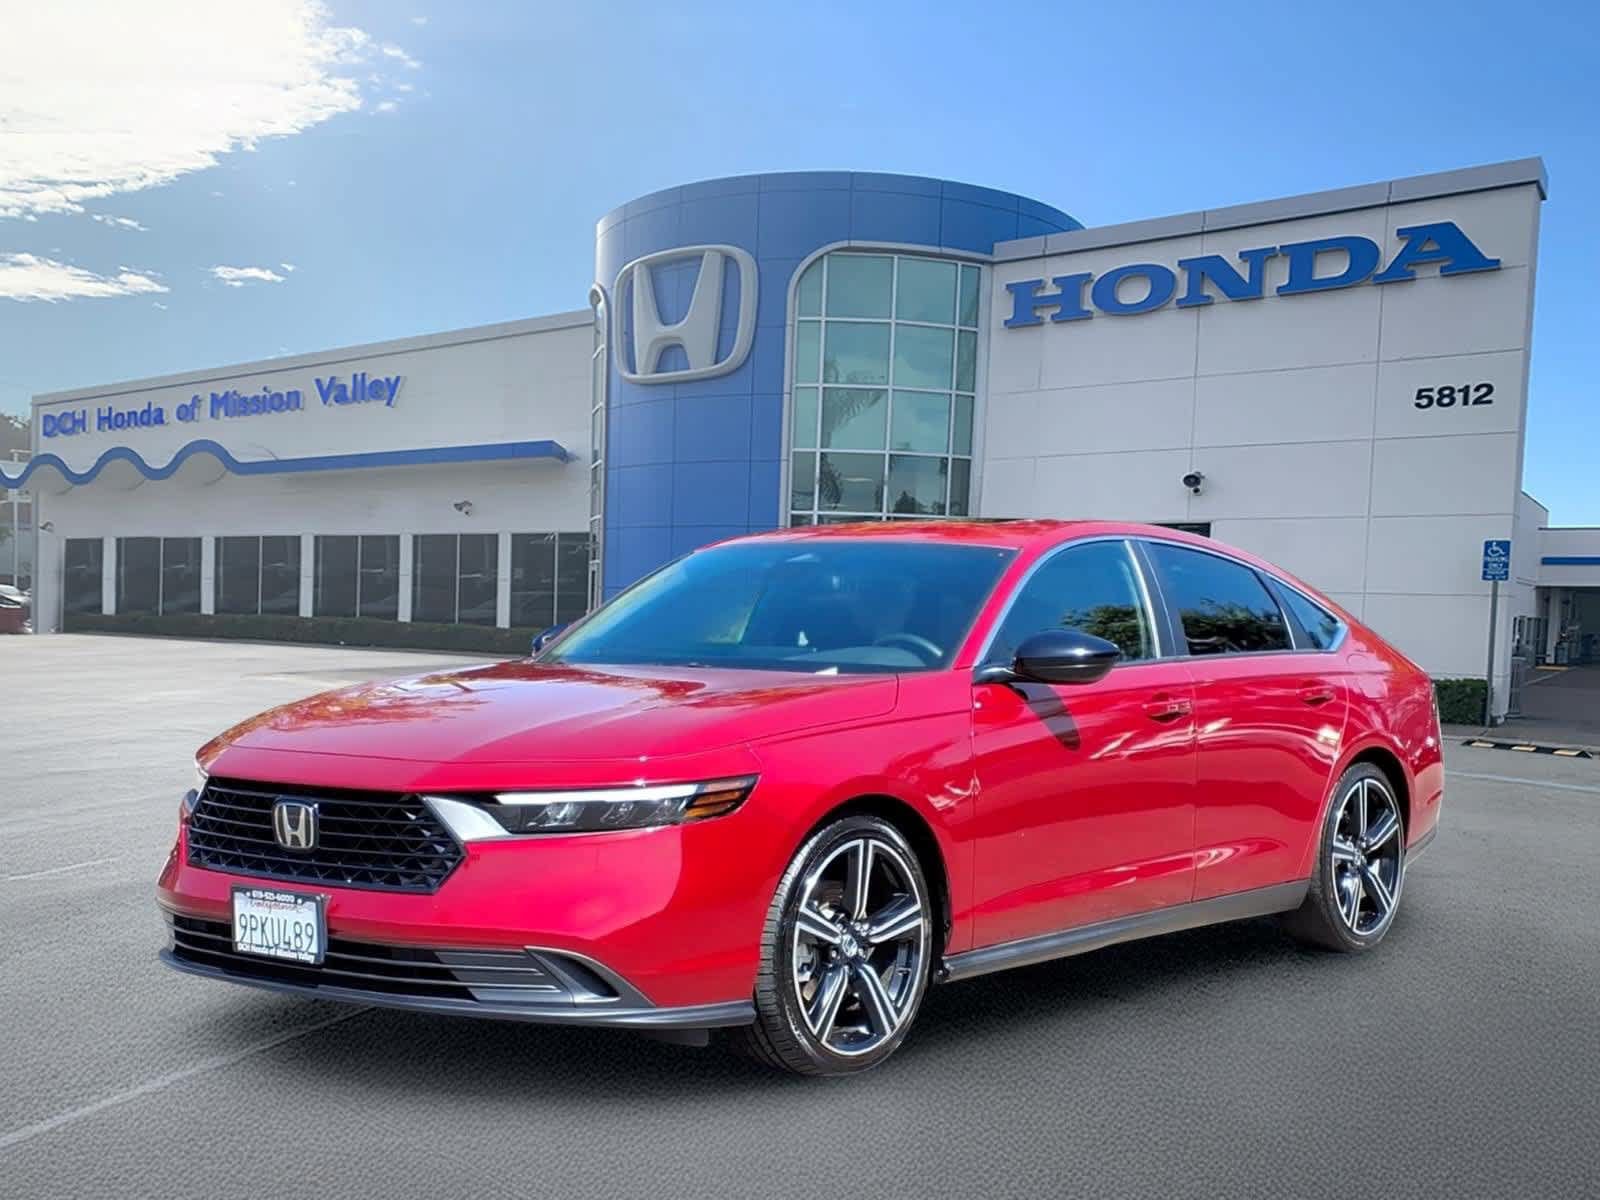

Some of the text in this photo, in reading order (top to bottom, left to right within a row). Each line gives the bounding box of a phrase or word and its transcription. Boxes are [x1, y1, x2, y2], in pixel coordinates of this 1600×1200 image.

[1003, 220, 1502, 328] HONDA
[41, 373, 403, 438] DCH Honda of Mission Valley
[1413, 382, 1495, 410] 5812
[239, 912, 315, 954] 9PKU489
